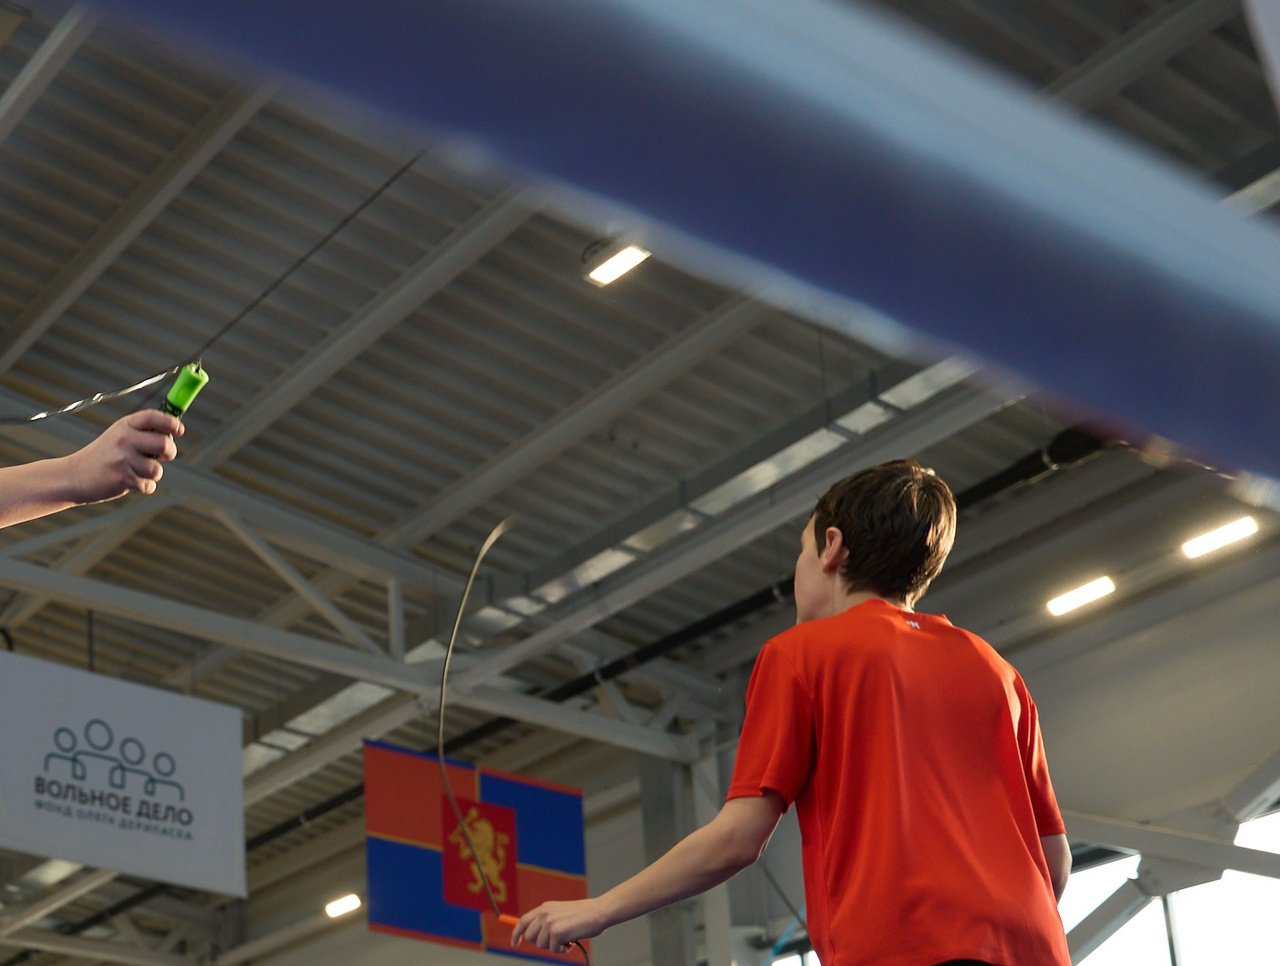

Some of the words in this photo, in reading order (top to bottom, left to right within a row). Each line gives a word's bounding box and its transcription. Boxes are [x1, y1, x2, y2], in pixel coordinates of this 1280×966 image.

[34, 775, 131, 815] ВОЛЬНОЕ
[136, 799, 194, 827] ДЕЛО
[34, 799, 74, 818] ФОНД
